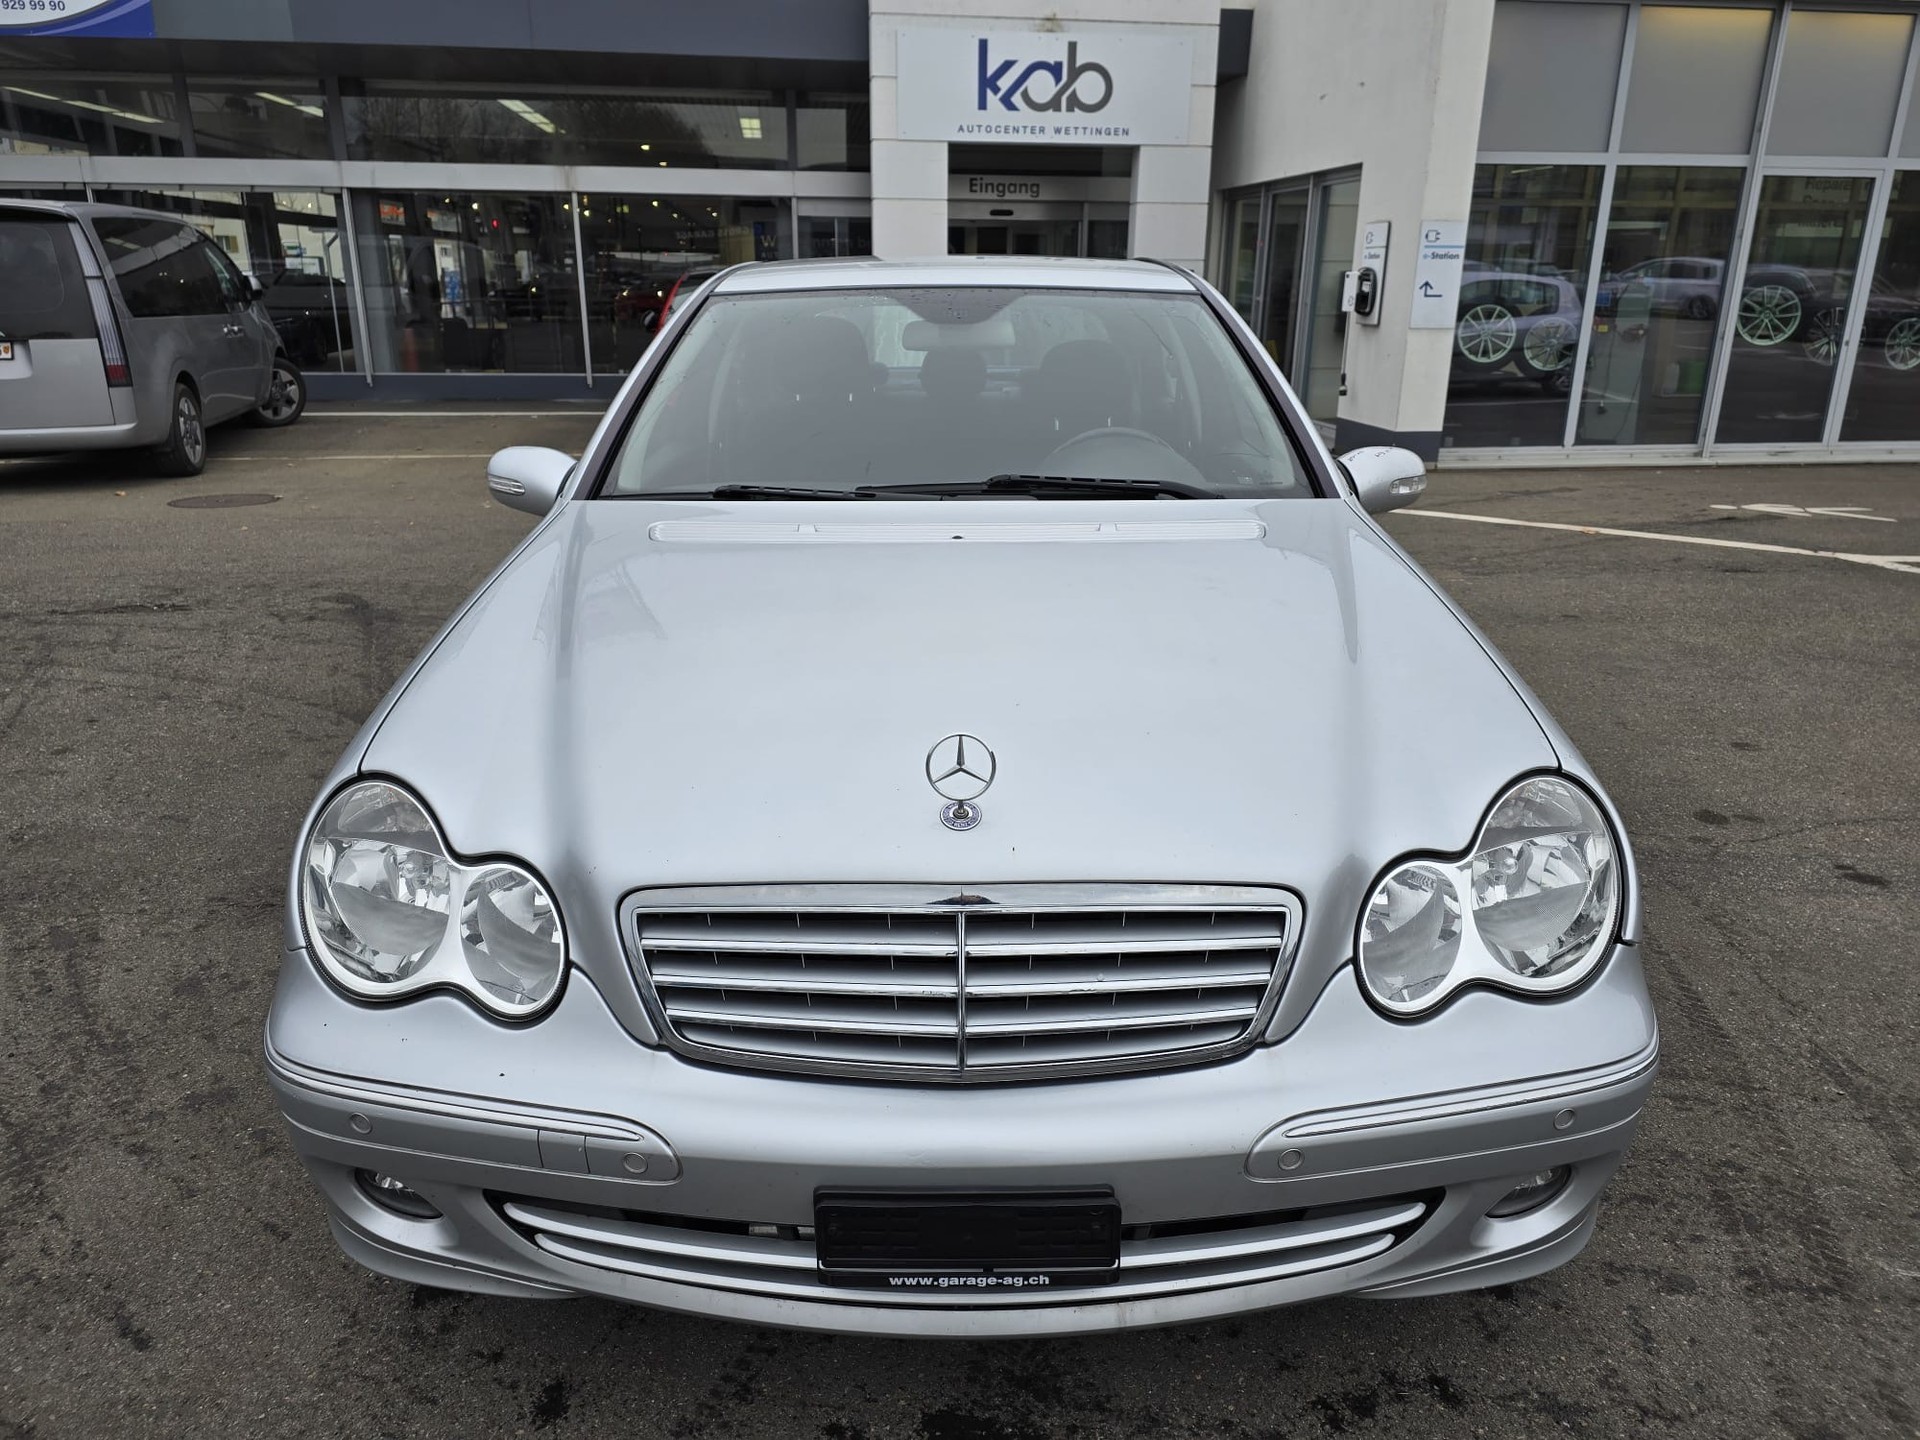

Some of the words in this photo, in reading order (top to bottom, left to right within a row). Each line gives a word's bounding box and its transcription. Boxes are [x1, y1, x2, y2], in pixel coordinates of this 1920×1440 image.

[2, 0, 26, 10] 929
[30, 0, 46, 11] 99
[50, 0, 66, 11] 90
[977, 38, 1114, 113] kab
[957, 124, 1046, 136] AUTOCENTER
[1053, 125, 1130, 137] WETTINGEN
[968, 177, 1041, 198] Eingang
[889, 1274, 1050, 1287] www.garage-ag.ch
